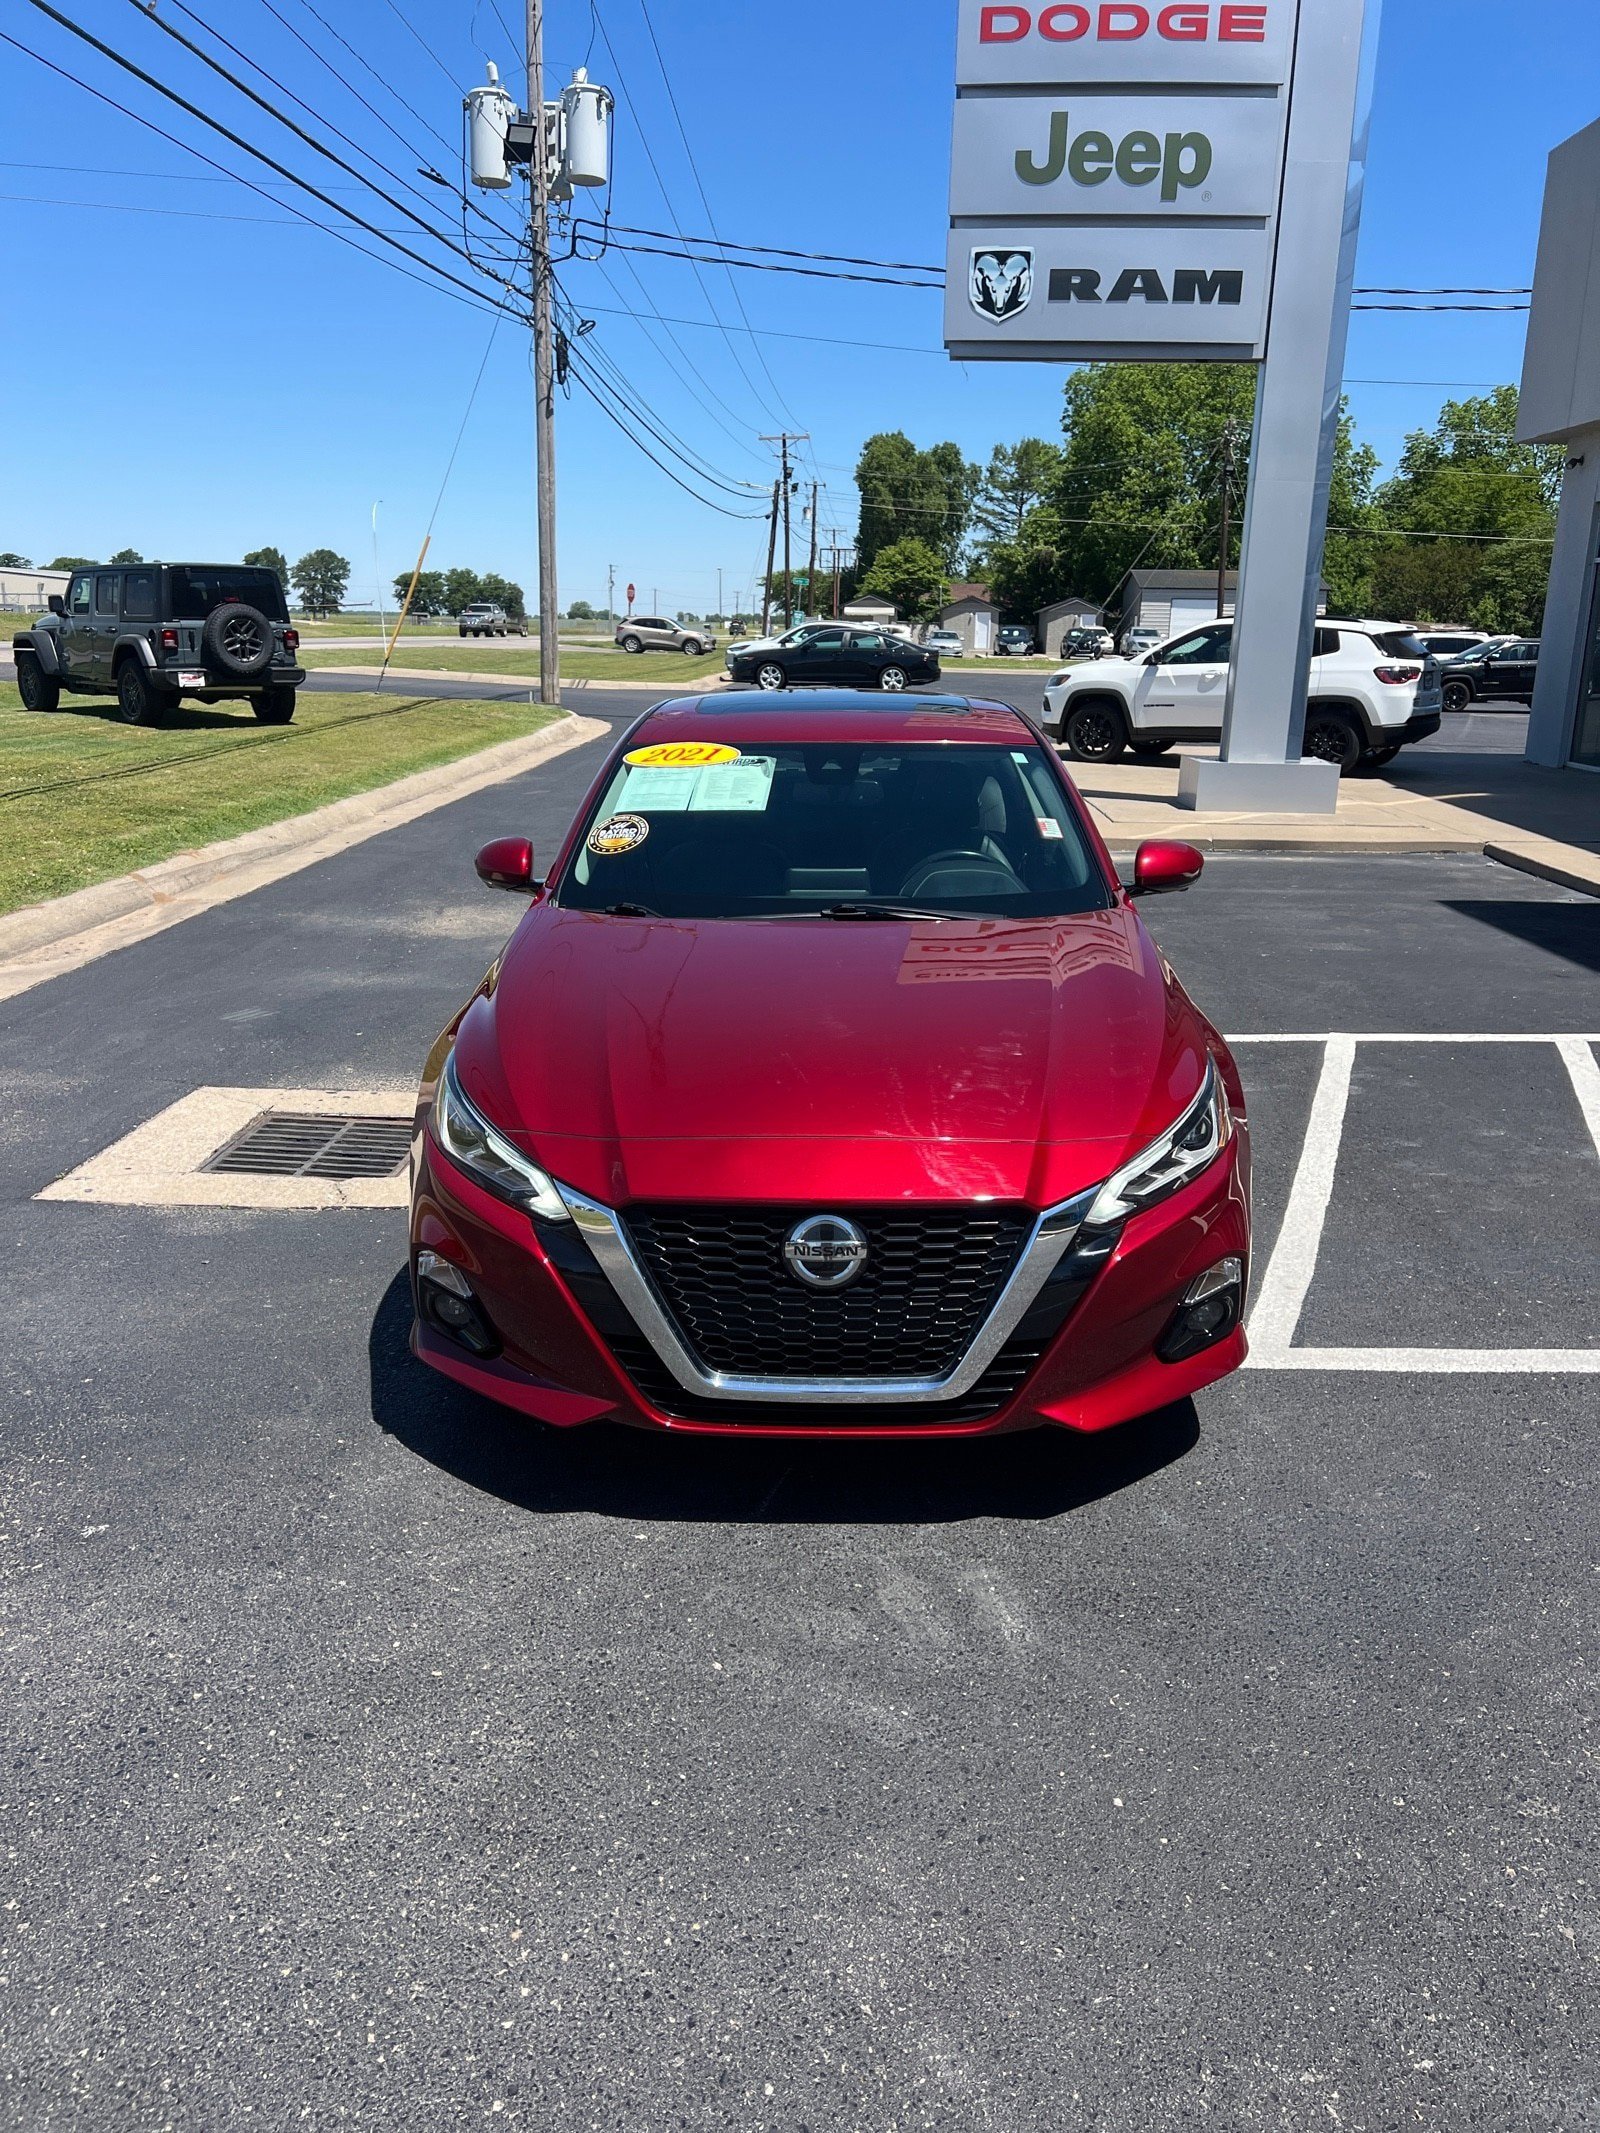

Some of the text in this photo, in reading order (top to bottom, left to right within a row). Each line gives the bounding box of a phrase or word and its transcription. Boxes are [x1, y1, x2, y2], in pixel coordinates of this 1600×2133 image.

[979, 3, 1268, 43] DODGE
[1014, 111, 1213, 202] Jeep
[1048, 268, 1244, 304] RAM
[641, 747, 723, 763] 2021
[794, 1245, 858, 1256] NISSAN
